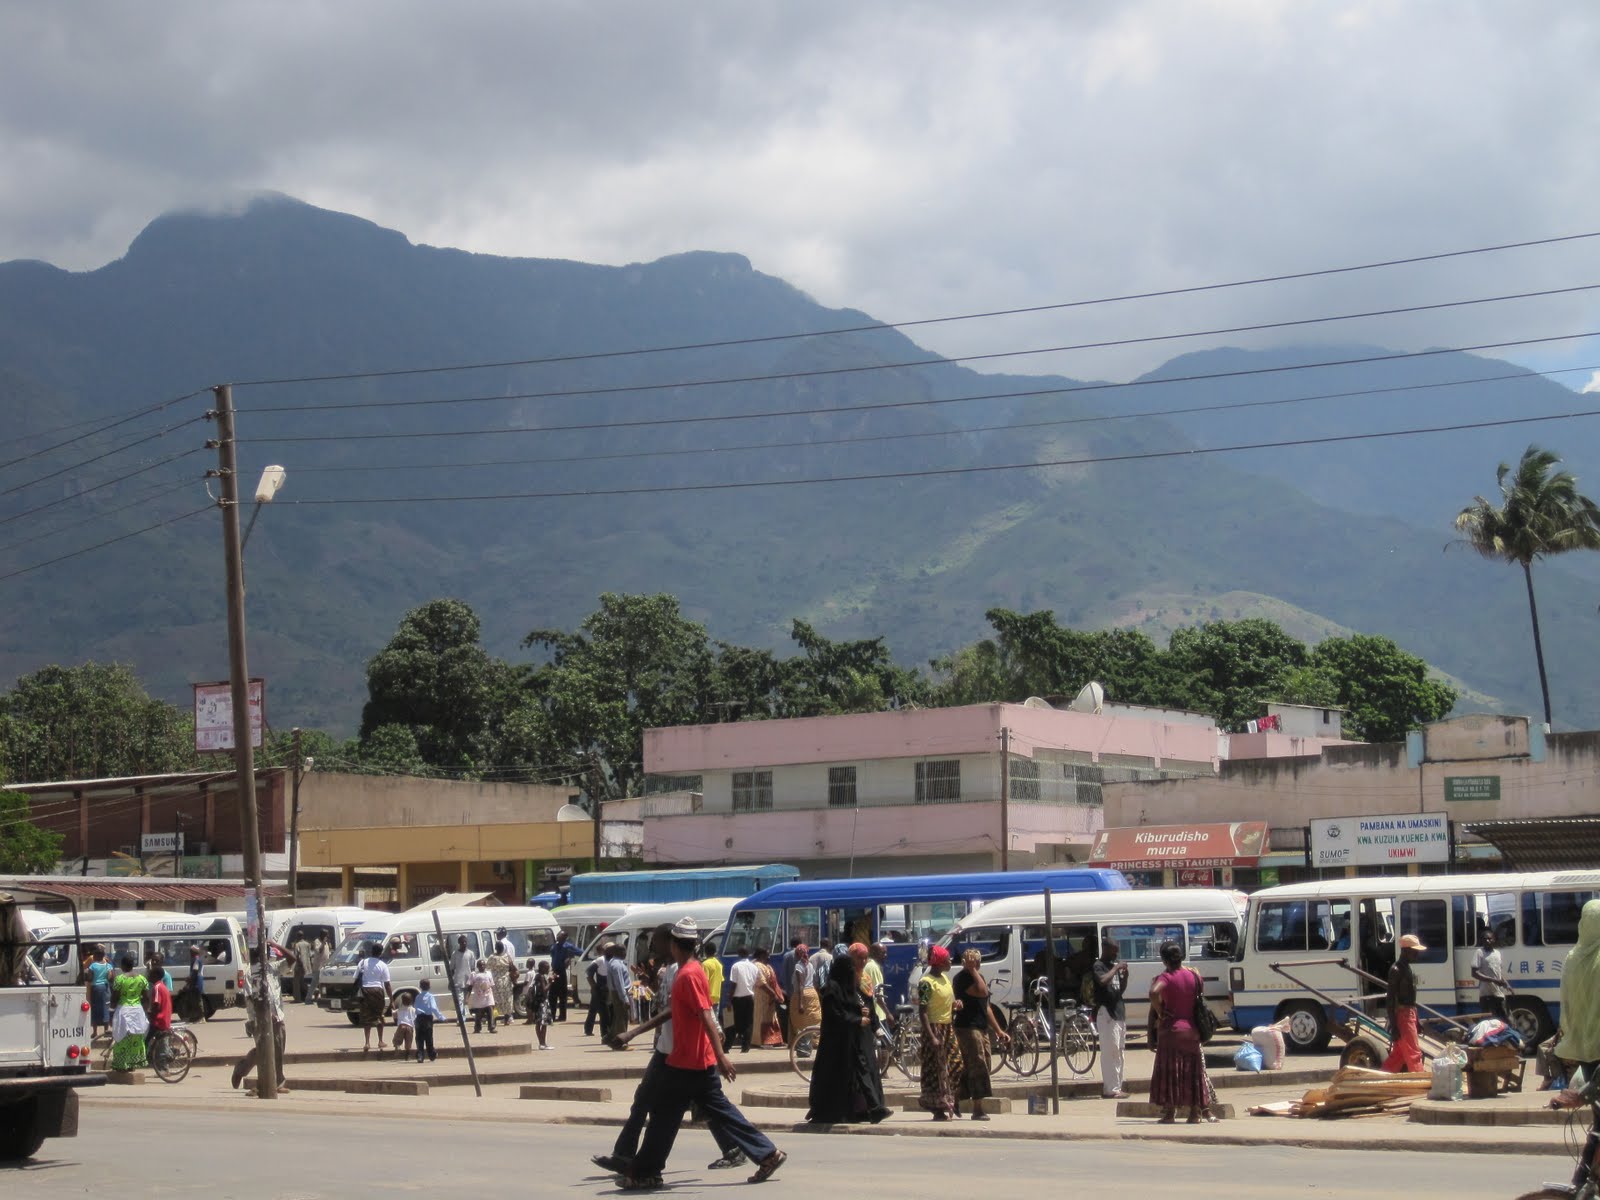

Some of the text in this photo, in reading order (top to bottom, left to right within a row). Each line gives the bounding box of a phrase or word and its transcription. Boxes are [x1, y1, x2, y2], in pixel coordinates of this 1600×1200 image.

[1360, 819, 1441, 830] PAMBANA NA UMASKINI
[1135, 831, 1209, 844] Kiburudisho
[1357, 832, 1446, 845] KWA KUZUIA KUENEA KWA
[1146, 845, 1187, 856] murua
[1319, 849, 1342, 859] SUMO
[1388, 848, 1416, 858] UKIMWI
[1110, 858, 1235, 870] PRINCESS RESTAURENT
[1181, 870, 1209, 881] Cocaola
[161, 923, 196, 931] Emirates
[52, 1027, 84, 1039] POLISI
